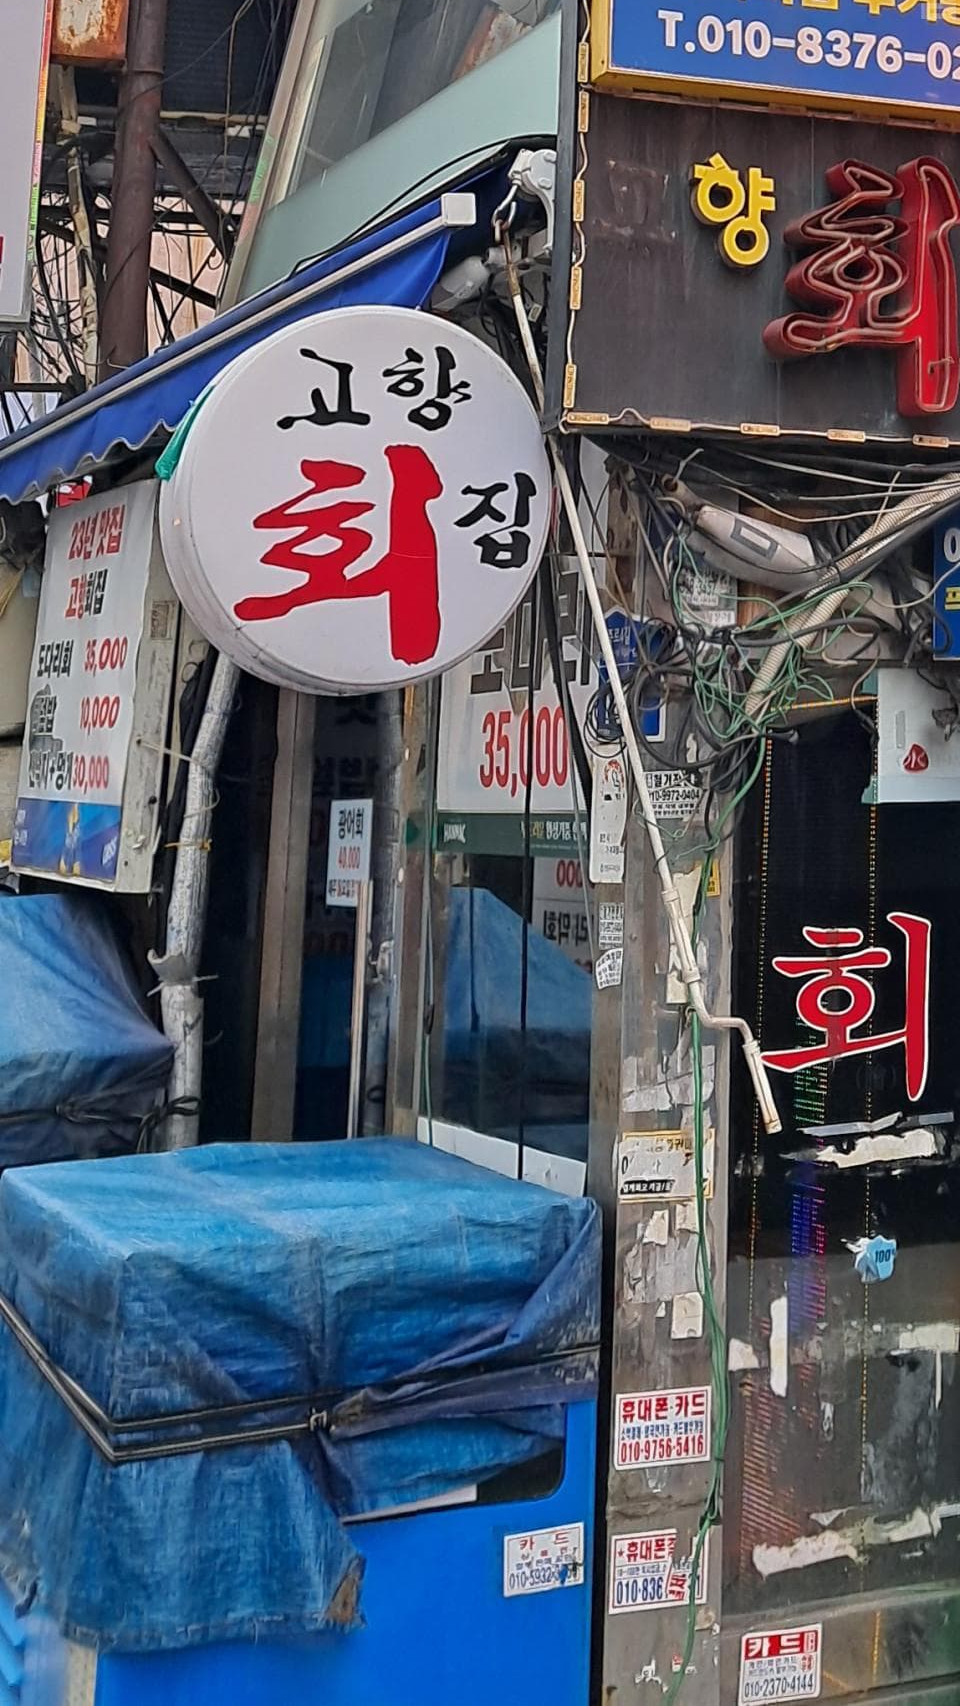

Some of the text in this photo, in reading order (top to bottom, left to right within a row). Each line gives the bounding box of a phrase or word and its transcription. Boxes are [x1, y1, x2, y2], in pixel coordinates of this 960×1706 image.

[689, 151, 776, 267] 향
[276, 344, 472, 432] 고향
[233, 443, 444, 667] 회
[453, 471, 538, 570] 집
[760, 911, 932, 1102] 회
